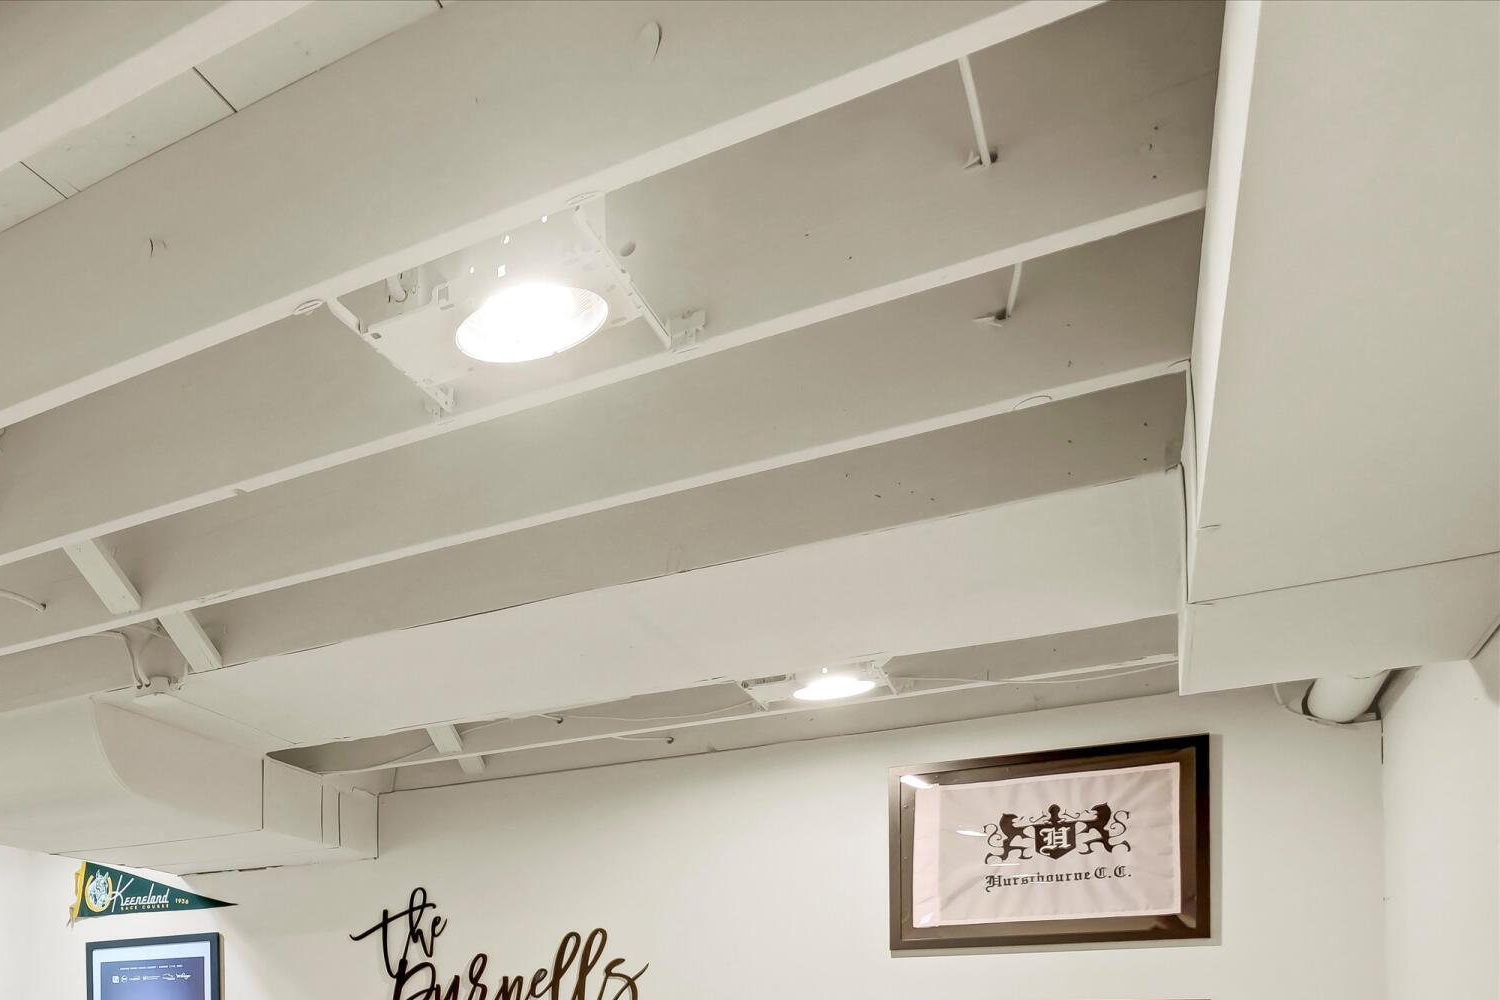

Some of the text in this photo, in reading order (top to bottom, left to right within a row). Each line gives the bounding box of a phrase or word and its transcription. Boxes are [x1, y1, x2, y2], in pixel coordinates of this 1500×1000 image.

[1039, 825, 1071, 857] H
[110, 874, 170, 913] Keeneland
[985, 871, 1091, 893] Hurstbourne
[349, 887, 448, 978] the
